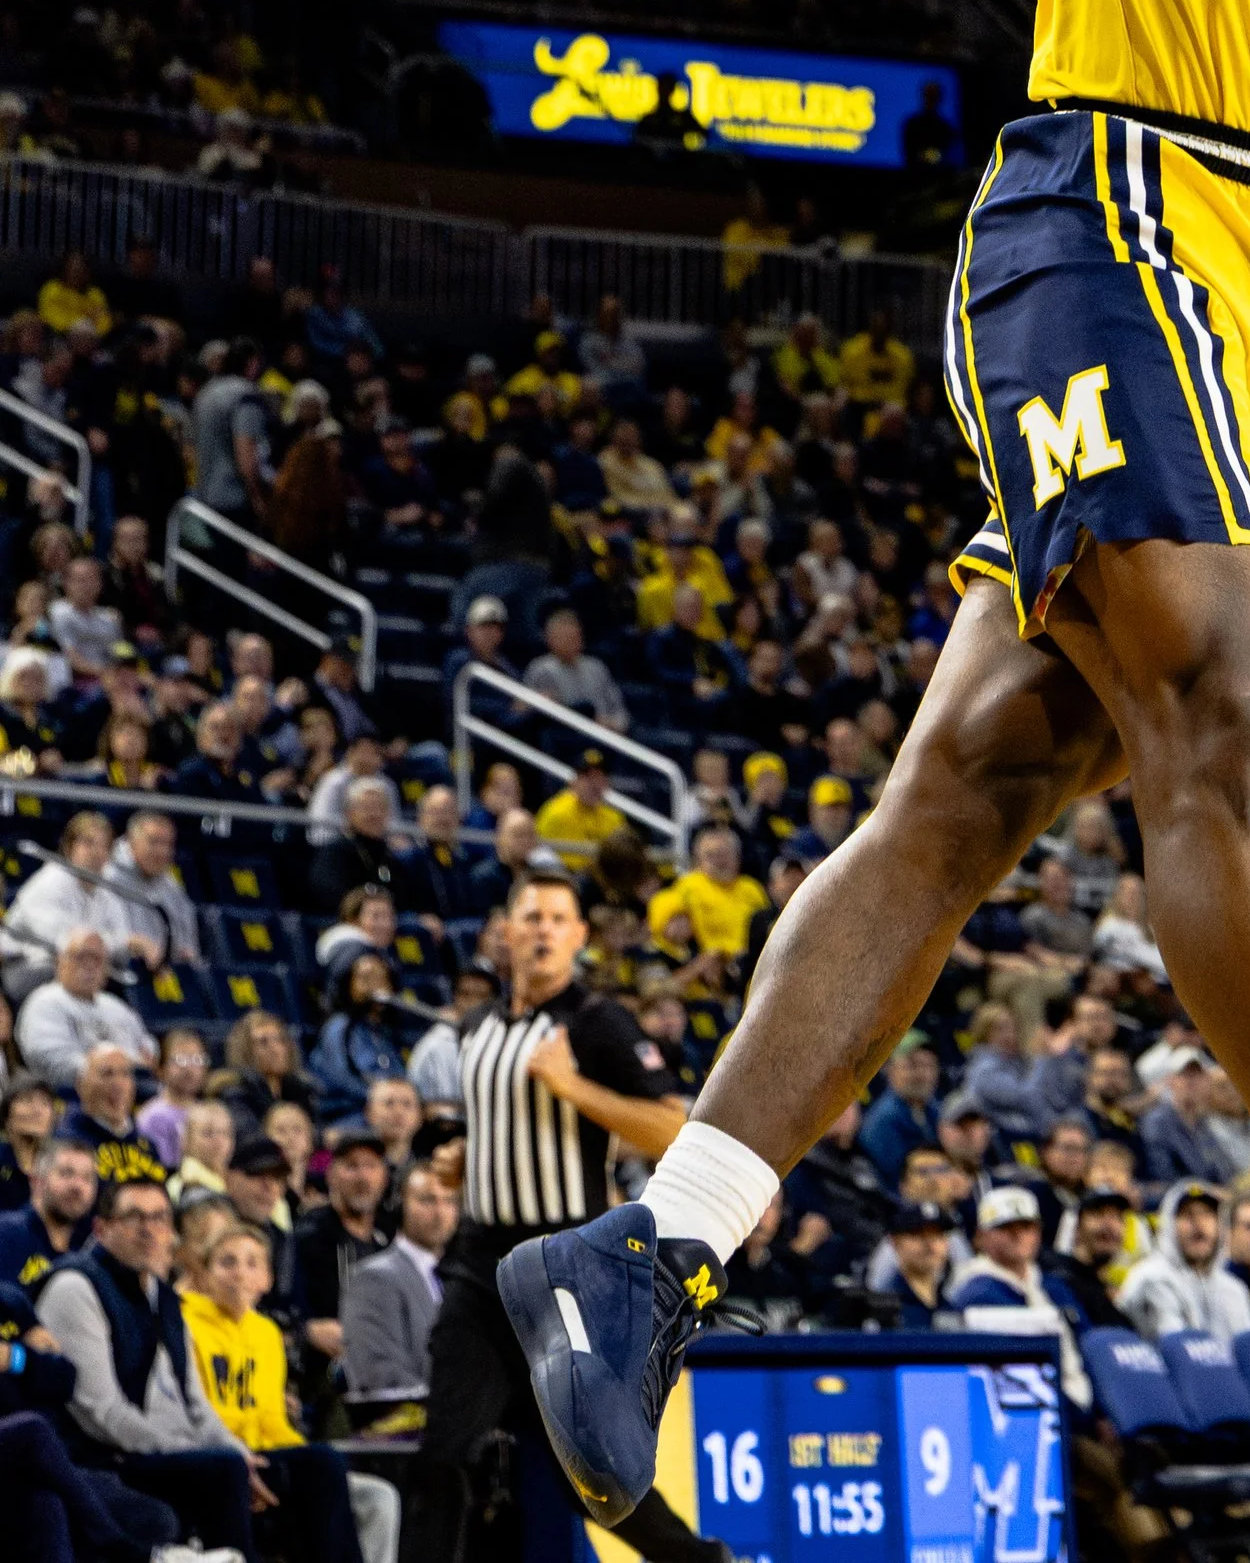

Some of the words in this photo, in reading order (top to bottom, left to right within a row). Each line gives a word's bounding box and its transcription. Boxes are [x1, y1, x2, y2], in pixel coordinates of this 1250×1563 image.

[1017, 364, 1126, 511] M
[683, 1263, 719, 1311] M
[702, 1429, 764, 1504] 16
[920, 1427, 951, 1496] 9
[792, 1481, 885, 1536] 11:55
